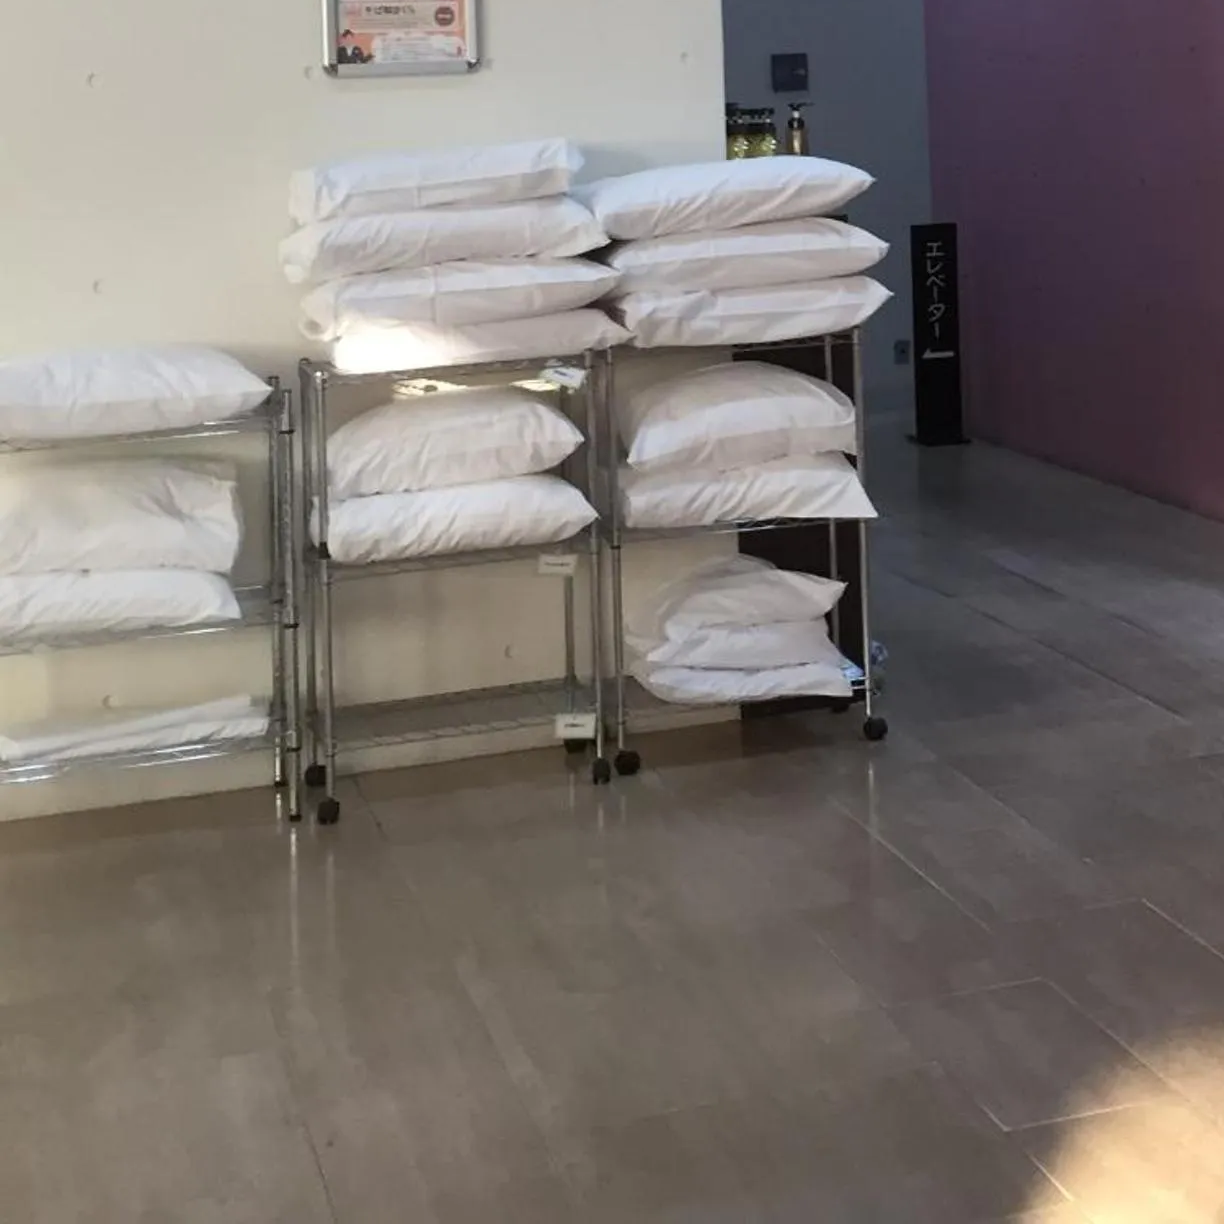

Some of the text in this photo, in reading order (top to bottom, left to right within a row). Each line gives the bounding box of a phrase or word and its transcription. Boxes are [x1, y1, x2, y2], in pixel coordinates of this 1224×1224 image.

[926, 240, 946, 339] エレベーター
